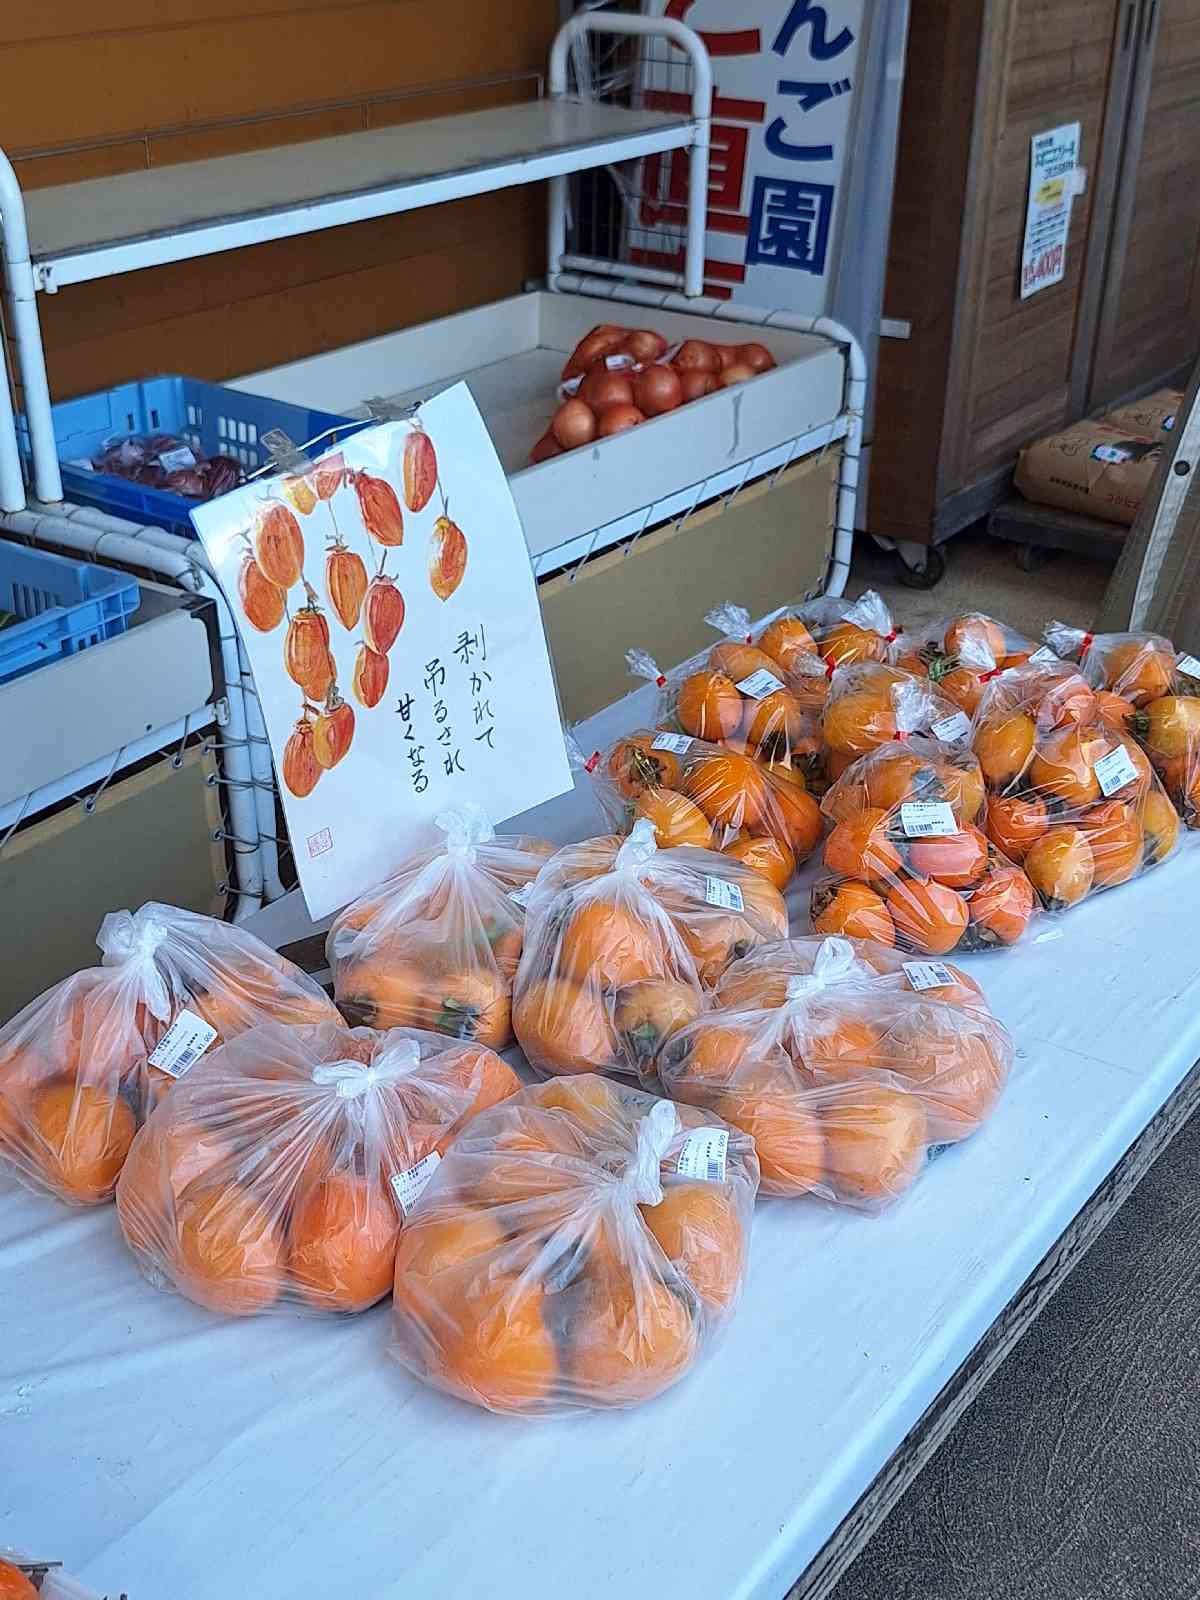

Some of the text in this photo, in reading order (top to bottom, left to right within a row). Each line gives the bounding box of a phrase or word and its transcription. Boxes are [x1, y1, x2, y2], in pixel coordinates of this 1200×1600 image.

[394, 692, 430, 794] 甘くなる
[423, 658, 466, 777] 吊るされ
[452, 623, 495, 749] 剥かれて
